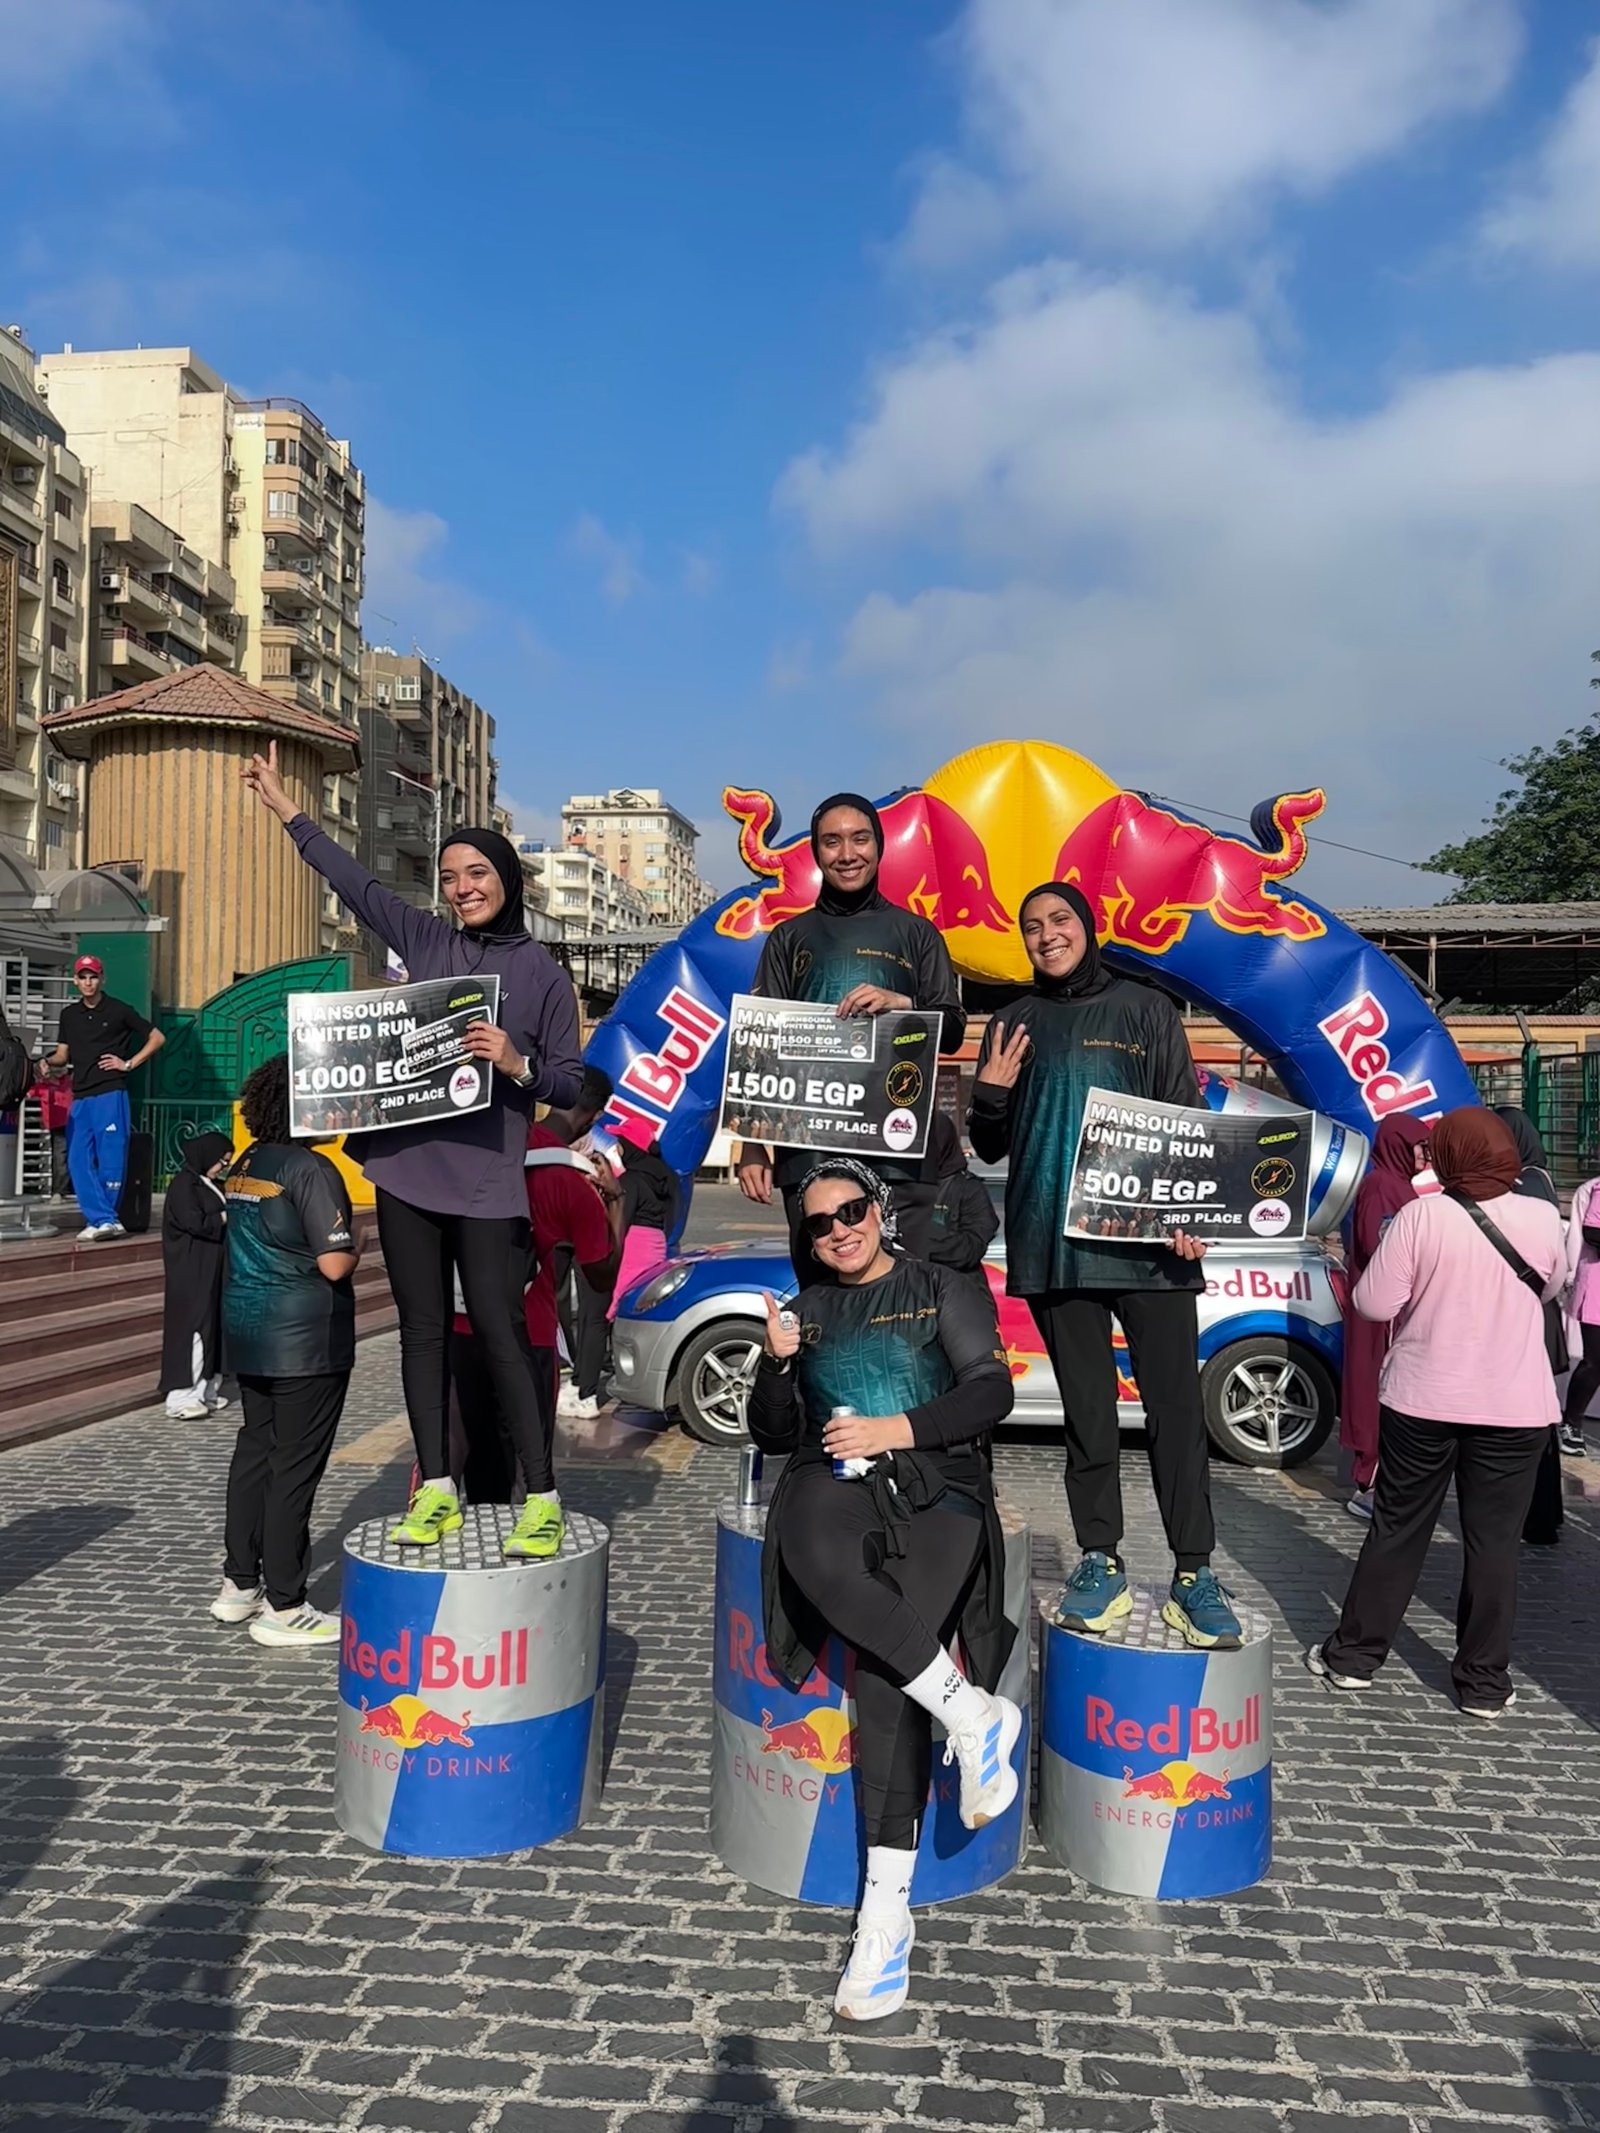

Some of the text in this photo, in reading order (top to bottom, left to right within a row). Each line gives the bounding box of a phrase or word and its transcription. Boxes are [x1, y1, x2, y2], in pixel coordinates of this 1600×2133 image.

[295, 1017, 417, 1043] UNITED RUN
[735, 1031, 779, 1049] UNIT
[781, 1035, 842, 1045] 1500 EGP
[408, 1048, 435, 1063] 1000
[622, 988, 723, 1109] Bull
[1321, 993, 1434, 1118] Red
[295, 1059, 409, 1091] 1000 EG
[727, 1071, 865, 1107] 1500 EGP
[380, 1087, 445, 1110] 2ND PLACE
[807, 1118, 833, 1131] 1ST
[835, 1120, 878, 1134] PLACE
[1090, 1102, 1206, 1138] MANSOURA
[1087, 1125, 1215, 1159] UNITED RUN
[1324, 1151, 1339, 1170] With
[1083, 1168, 1218, 1201] 500 EGP
[1162, 1213, 1242, 1225] 3RD PLACE
[1204, 1269, 1312, 1301] ed Bull
[343, 1616, 528, 1689] Red Bull
[1086, 1694, 1260, 1754] Red Bull
[427, 1753, 513, 1777] DRINK
[734, 1755, 840, 1805] ENERGY
[1094, 1802, 1253, 1829] ENERGY DRINK
